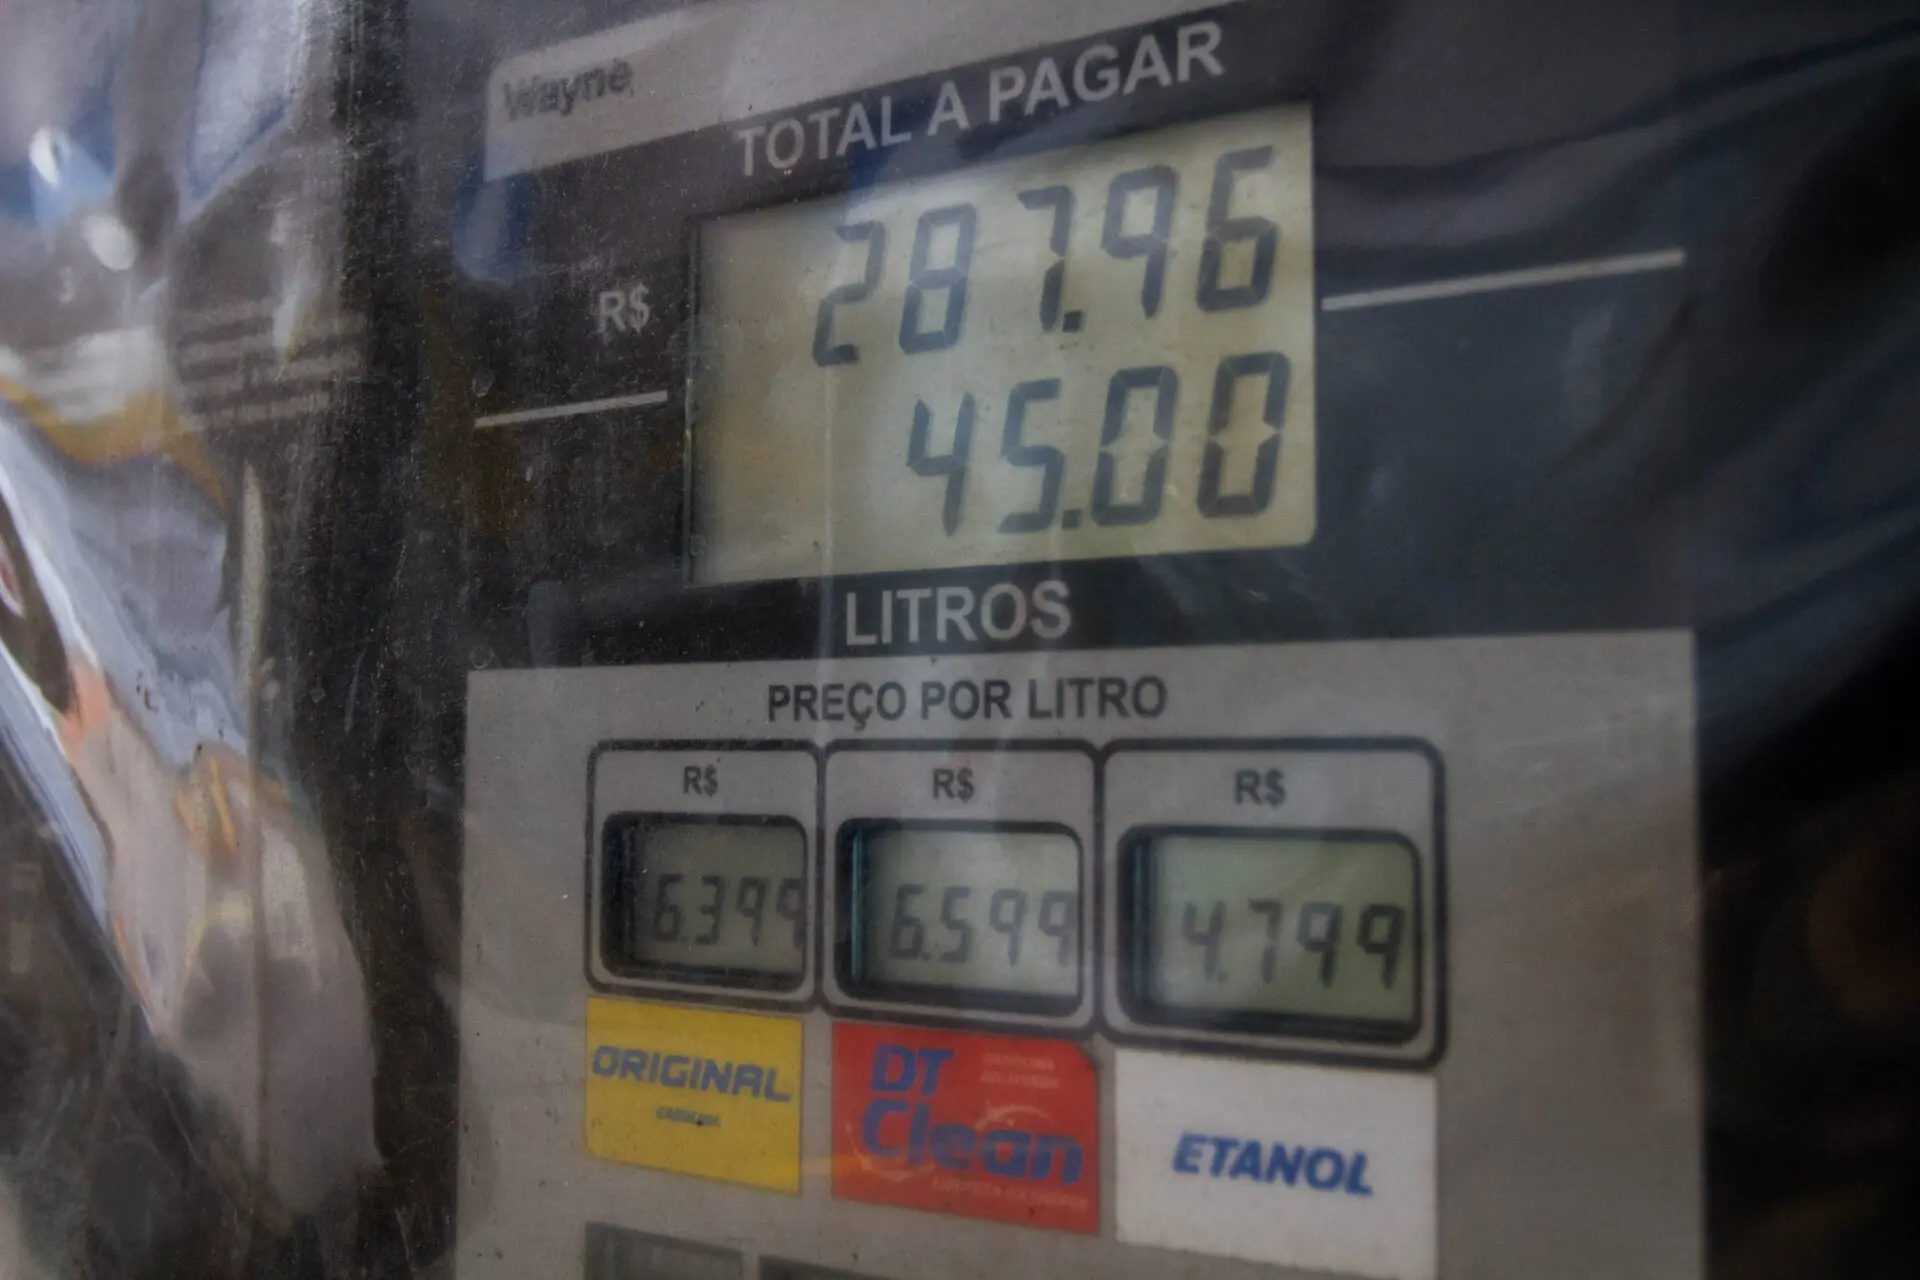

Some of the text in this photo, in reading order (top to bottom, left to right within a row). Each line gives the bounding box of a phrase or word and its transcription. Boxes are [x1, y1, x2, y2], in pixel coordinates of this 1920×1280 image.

[502, 59, 635, 121] Wayne
[737, 20, 1225, 177] TOTAL A PAGAR
[812, 145, 1280, 368] 287.96
[598, 283, 650, 334] R$
[907, 351, 1292, 537] 45.00
[846, 579, 1073, 646] LITROS
[767, 675, 1169, 732] PREÇO POR LITRO
[684, 765, 719, 796] R$
[932, 767, 975, 803] R$
[1234, 768, 1286, 808] R$
[591, 1045, 792, 1103] ORIGINAL
[870, 1044, 957, 1097] DT
[860, 1098, 1084, 1187] Clean
[1173, 1132, 1373, 1197] ETANOL
